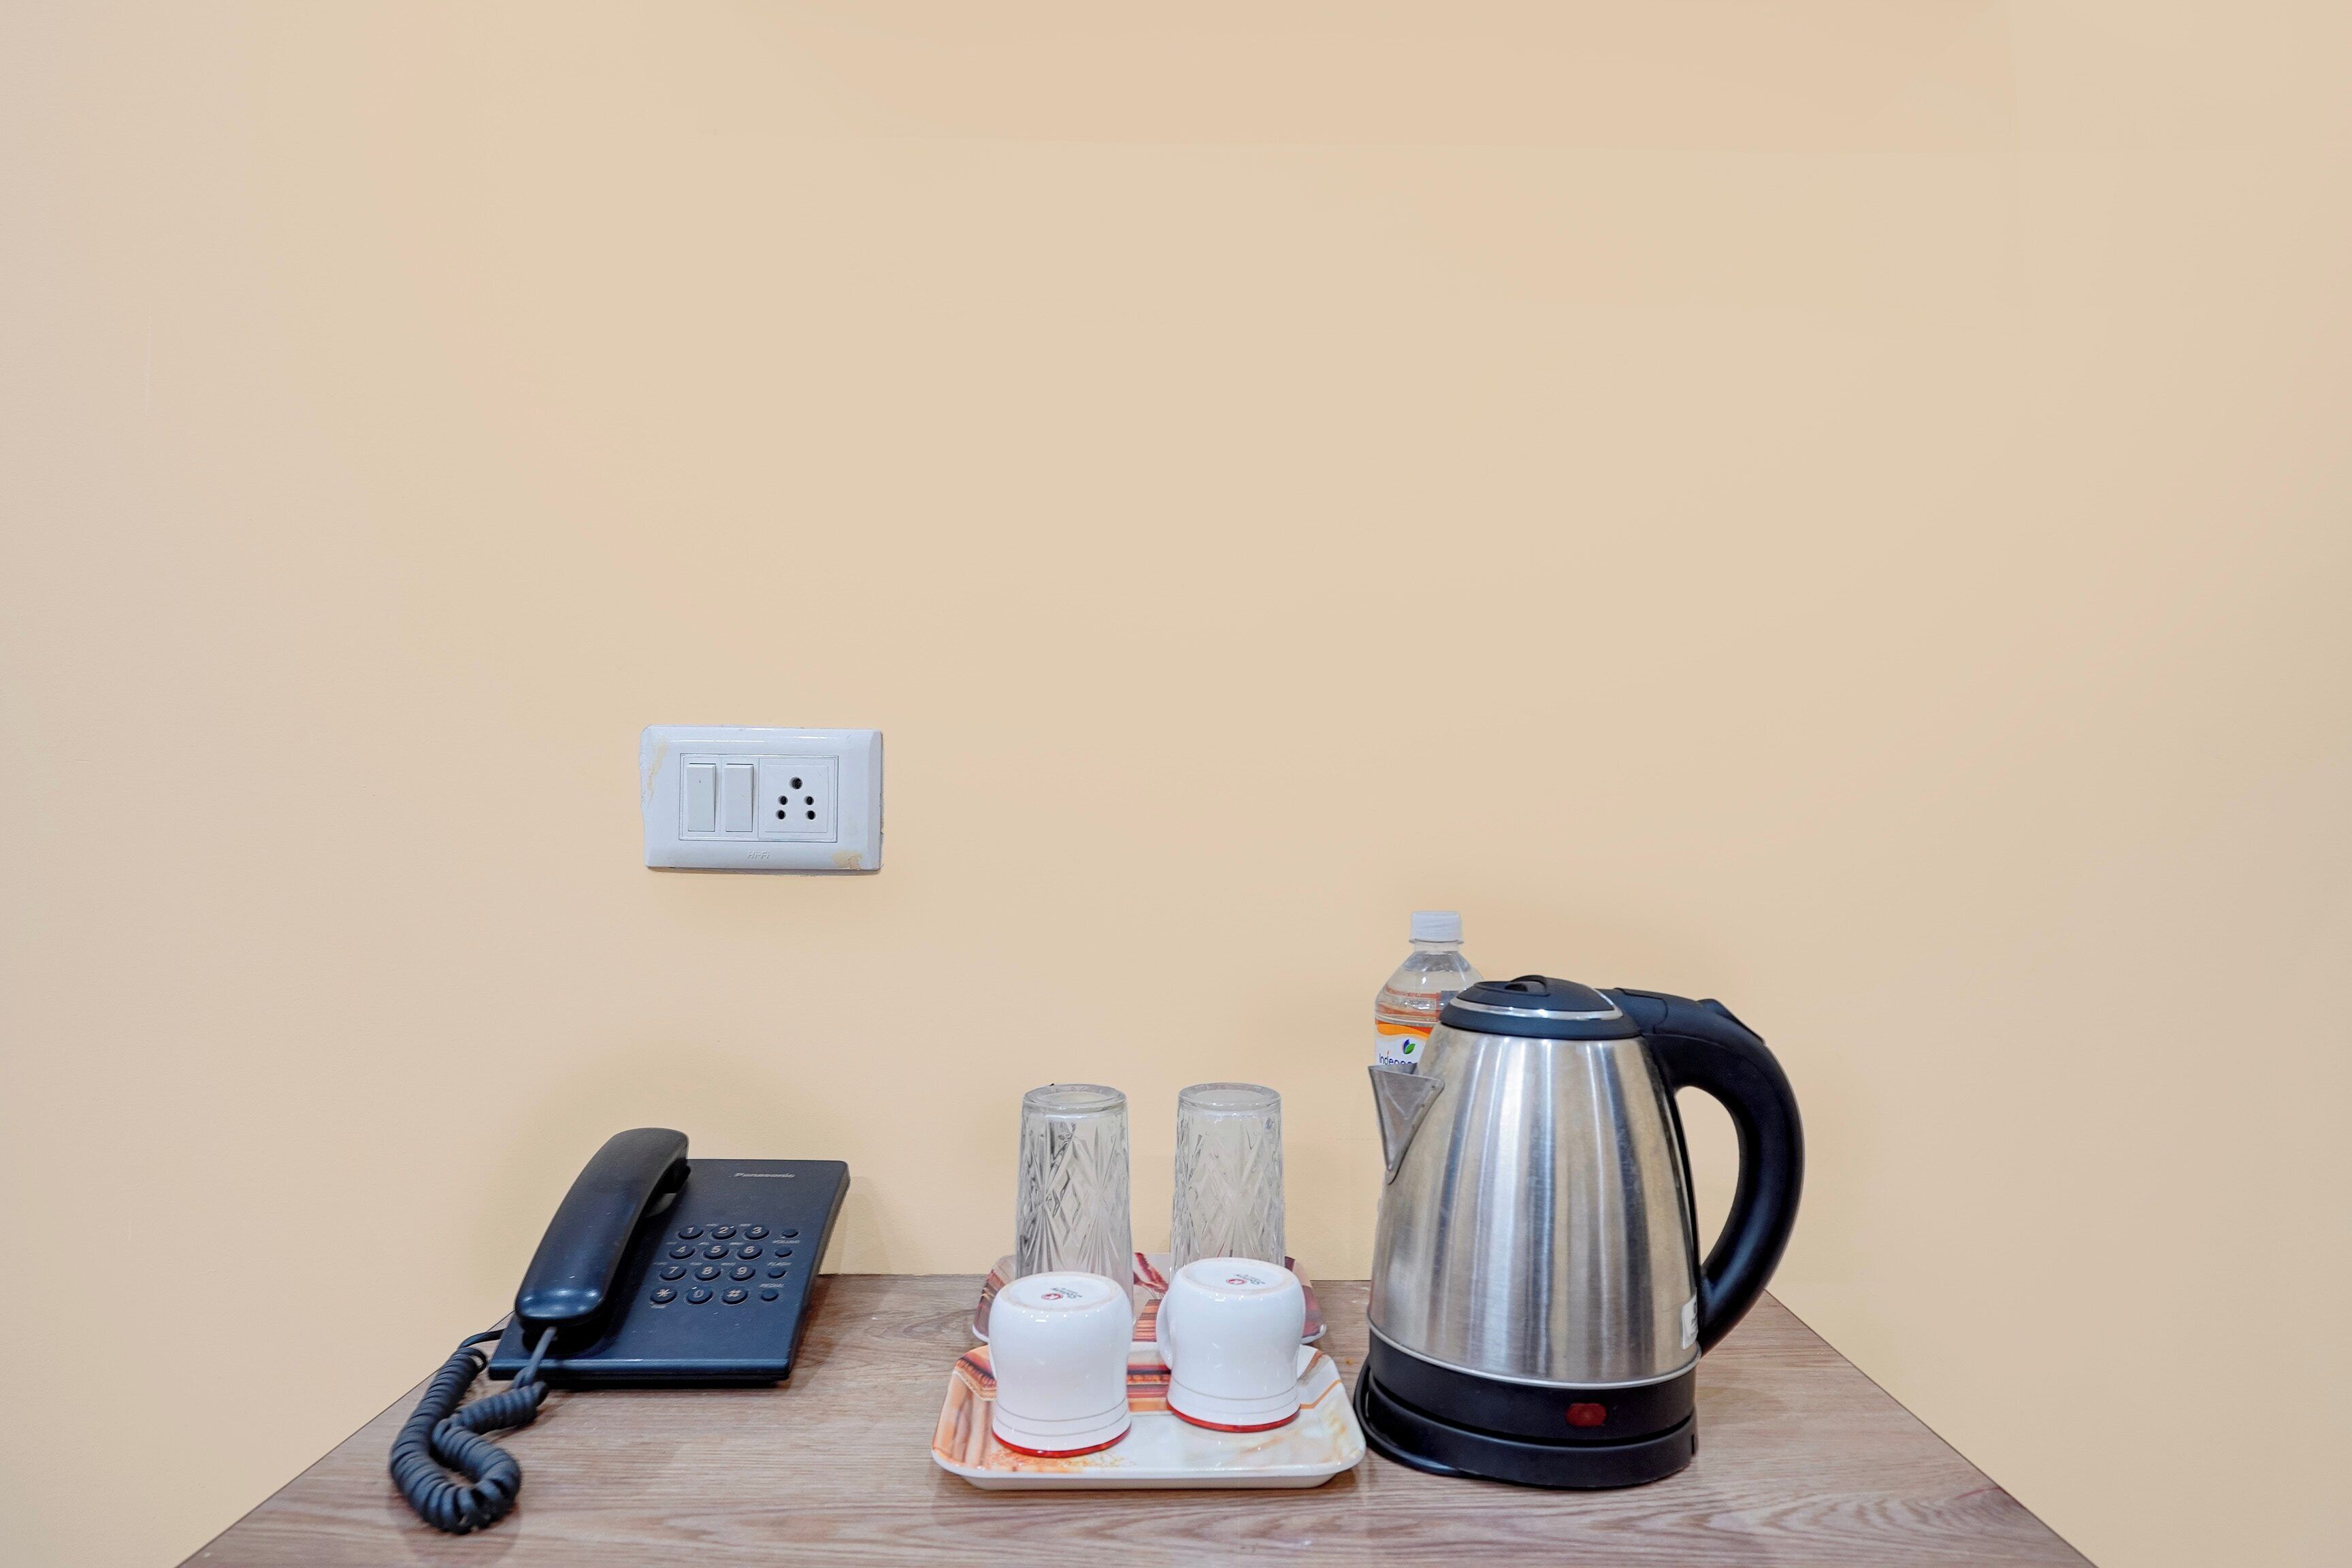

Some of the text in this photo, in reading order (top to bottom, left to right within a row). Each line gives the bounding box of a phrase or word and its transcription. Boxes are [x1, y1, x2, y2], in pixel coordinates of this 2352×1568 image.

[746, 851, 770, 860] Hi-Fi
[701, 1267, 713, 1275] 8
[736, 1267, 747, 1275] 9
[693, 1290, 704, 1298] 0
[726, 1289, 742, 1298] #
